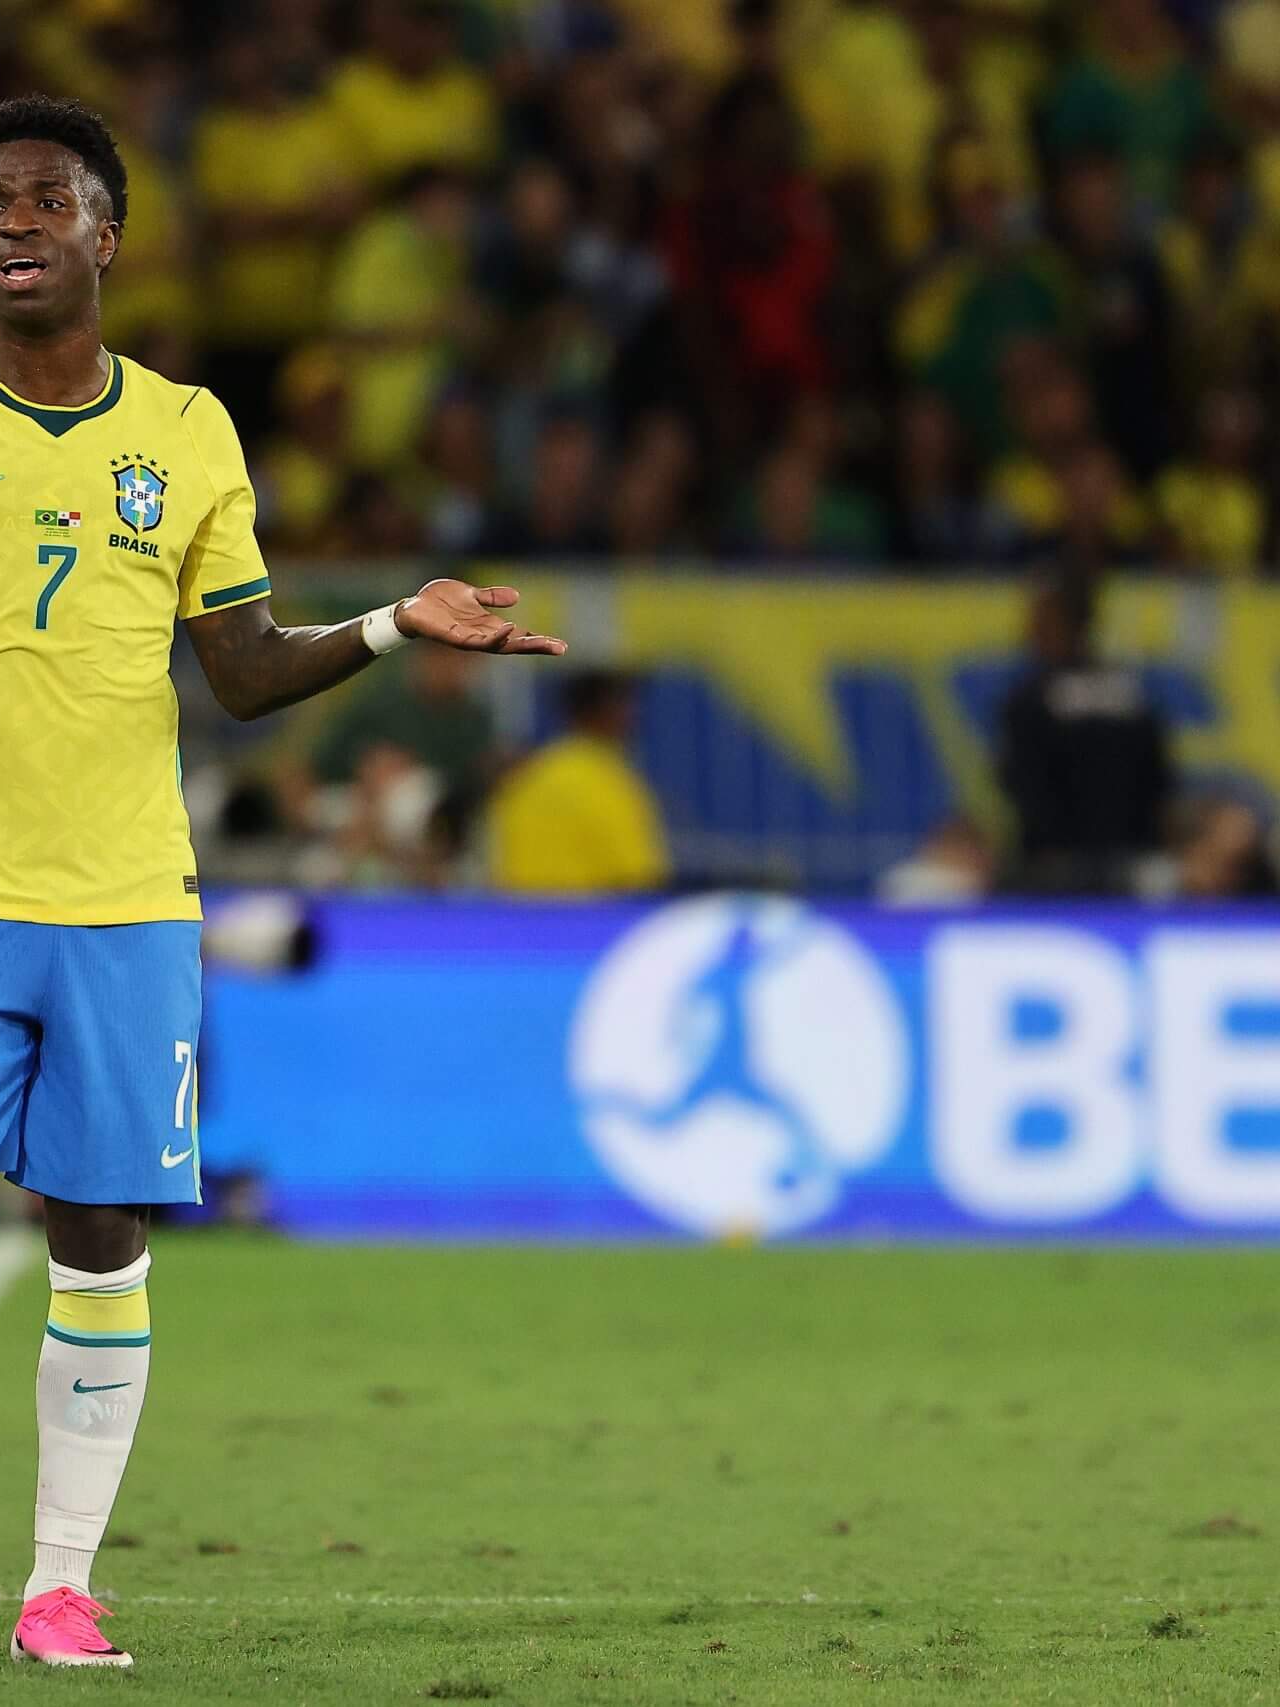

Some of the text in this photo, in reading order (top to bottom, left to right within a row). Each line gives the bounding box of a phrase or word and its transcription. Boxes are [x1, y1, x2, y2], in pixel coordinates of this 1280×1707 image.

[130, 489, 151, 502] CBF
[108, 533, 160, 559] BRASIL
[35, 544, 78, 630] 7
[174, 1040, 192, 1129] 7
